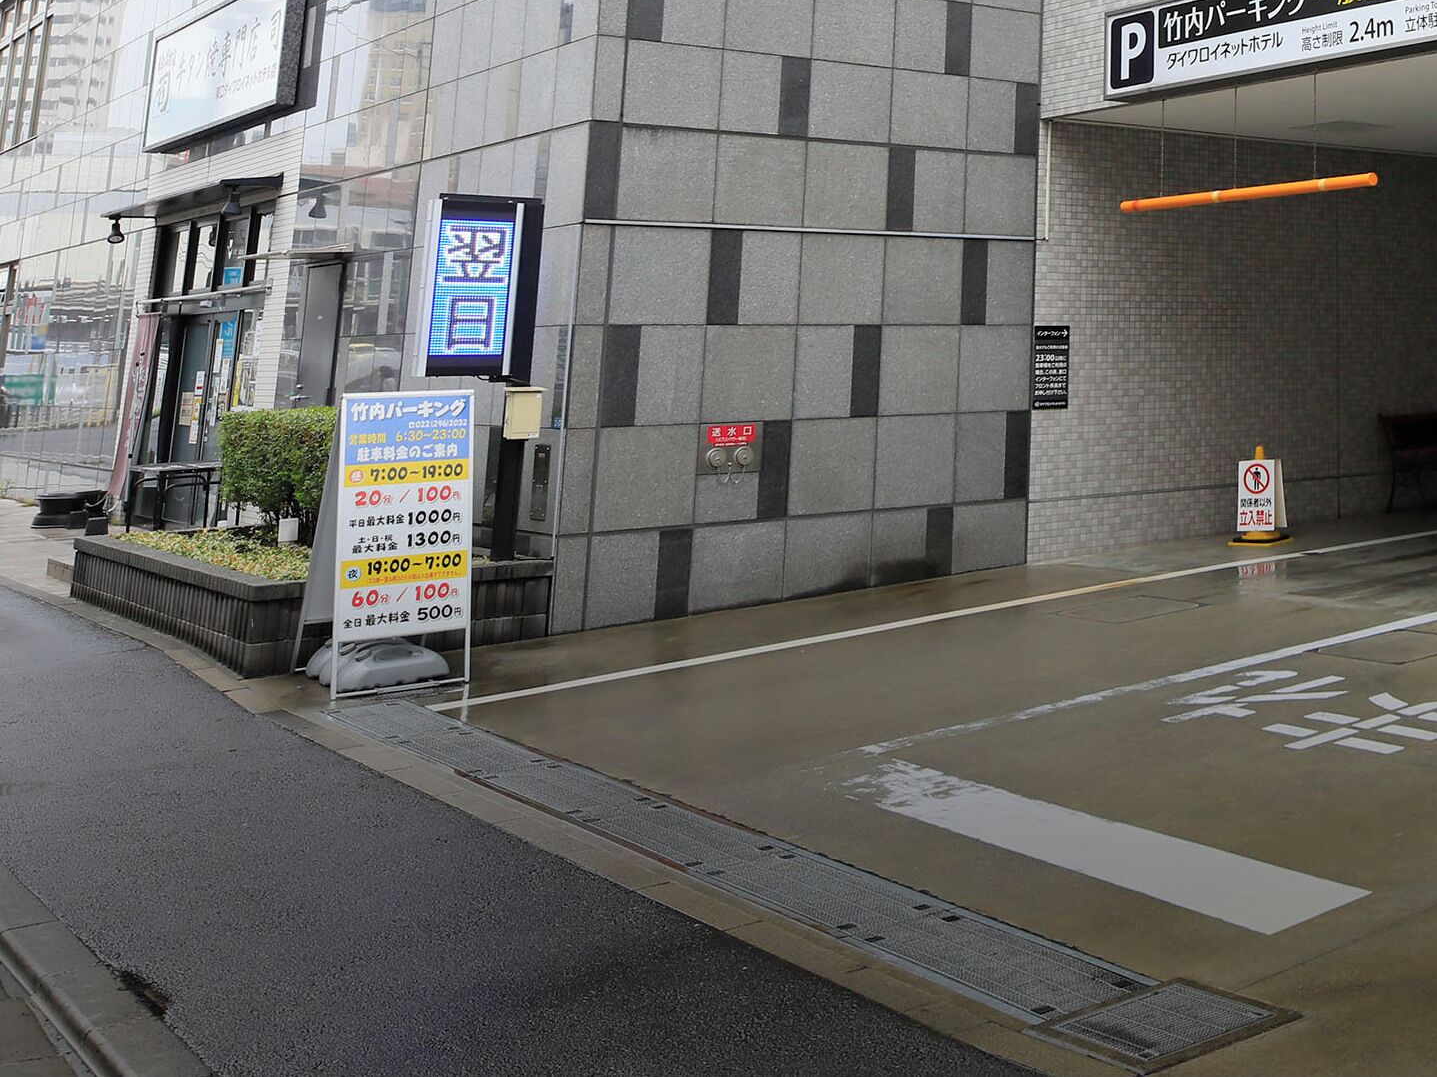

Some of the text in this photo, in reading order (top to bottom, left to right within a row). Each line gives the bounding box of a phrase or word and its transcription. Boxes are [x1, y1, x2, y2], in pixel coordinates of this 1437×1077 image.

[1405, 2, 1429, 14] Parking
[1302, 21, 1338, 35] Height Limit
[1120, 22, 1147, 80] P
[1167, 32, 1283, 70] ダイワロイネットホテル
[1301, 29, 1343, 52] 高さ制限
[1349, 18, 1394, 43] 2.4m
[443, 225, 507, 351] 翌日
[351, 398, 466, 421] 竹内パーキング
[350, 433, 386, 445] 営業時間
[712, 426, 752, 437] 送水口
[357, 443, 458, 462] 駐車料金のご案内
[355, 490, 393, 506] 20分
[418, 485, 461, 502] 100円
[1240, 498, 1272, 508] 関係者以外
[349, 509, 461, 528] 平日最大料金 1000円
[1240, 510, 1272, 526] 立入禁止
[352, 531, 461, 554] 最大料金 1300円
[352, 590, 390, 608] 60分
[416, 583, 459, 601] 100円
[418, 605, 462, 621] 500円
